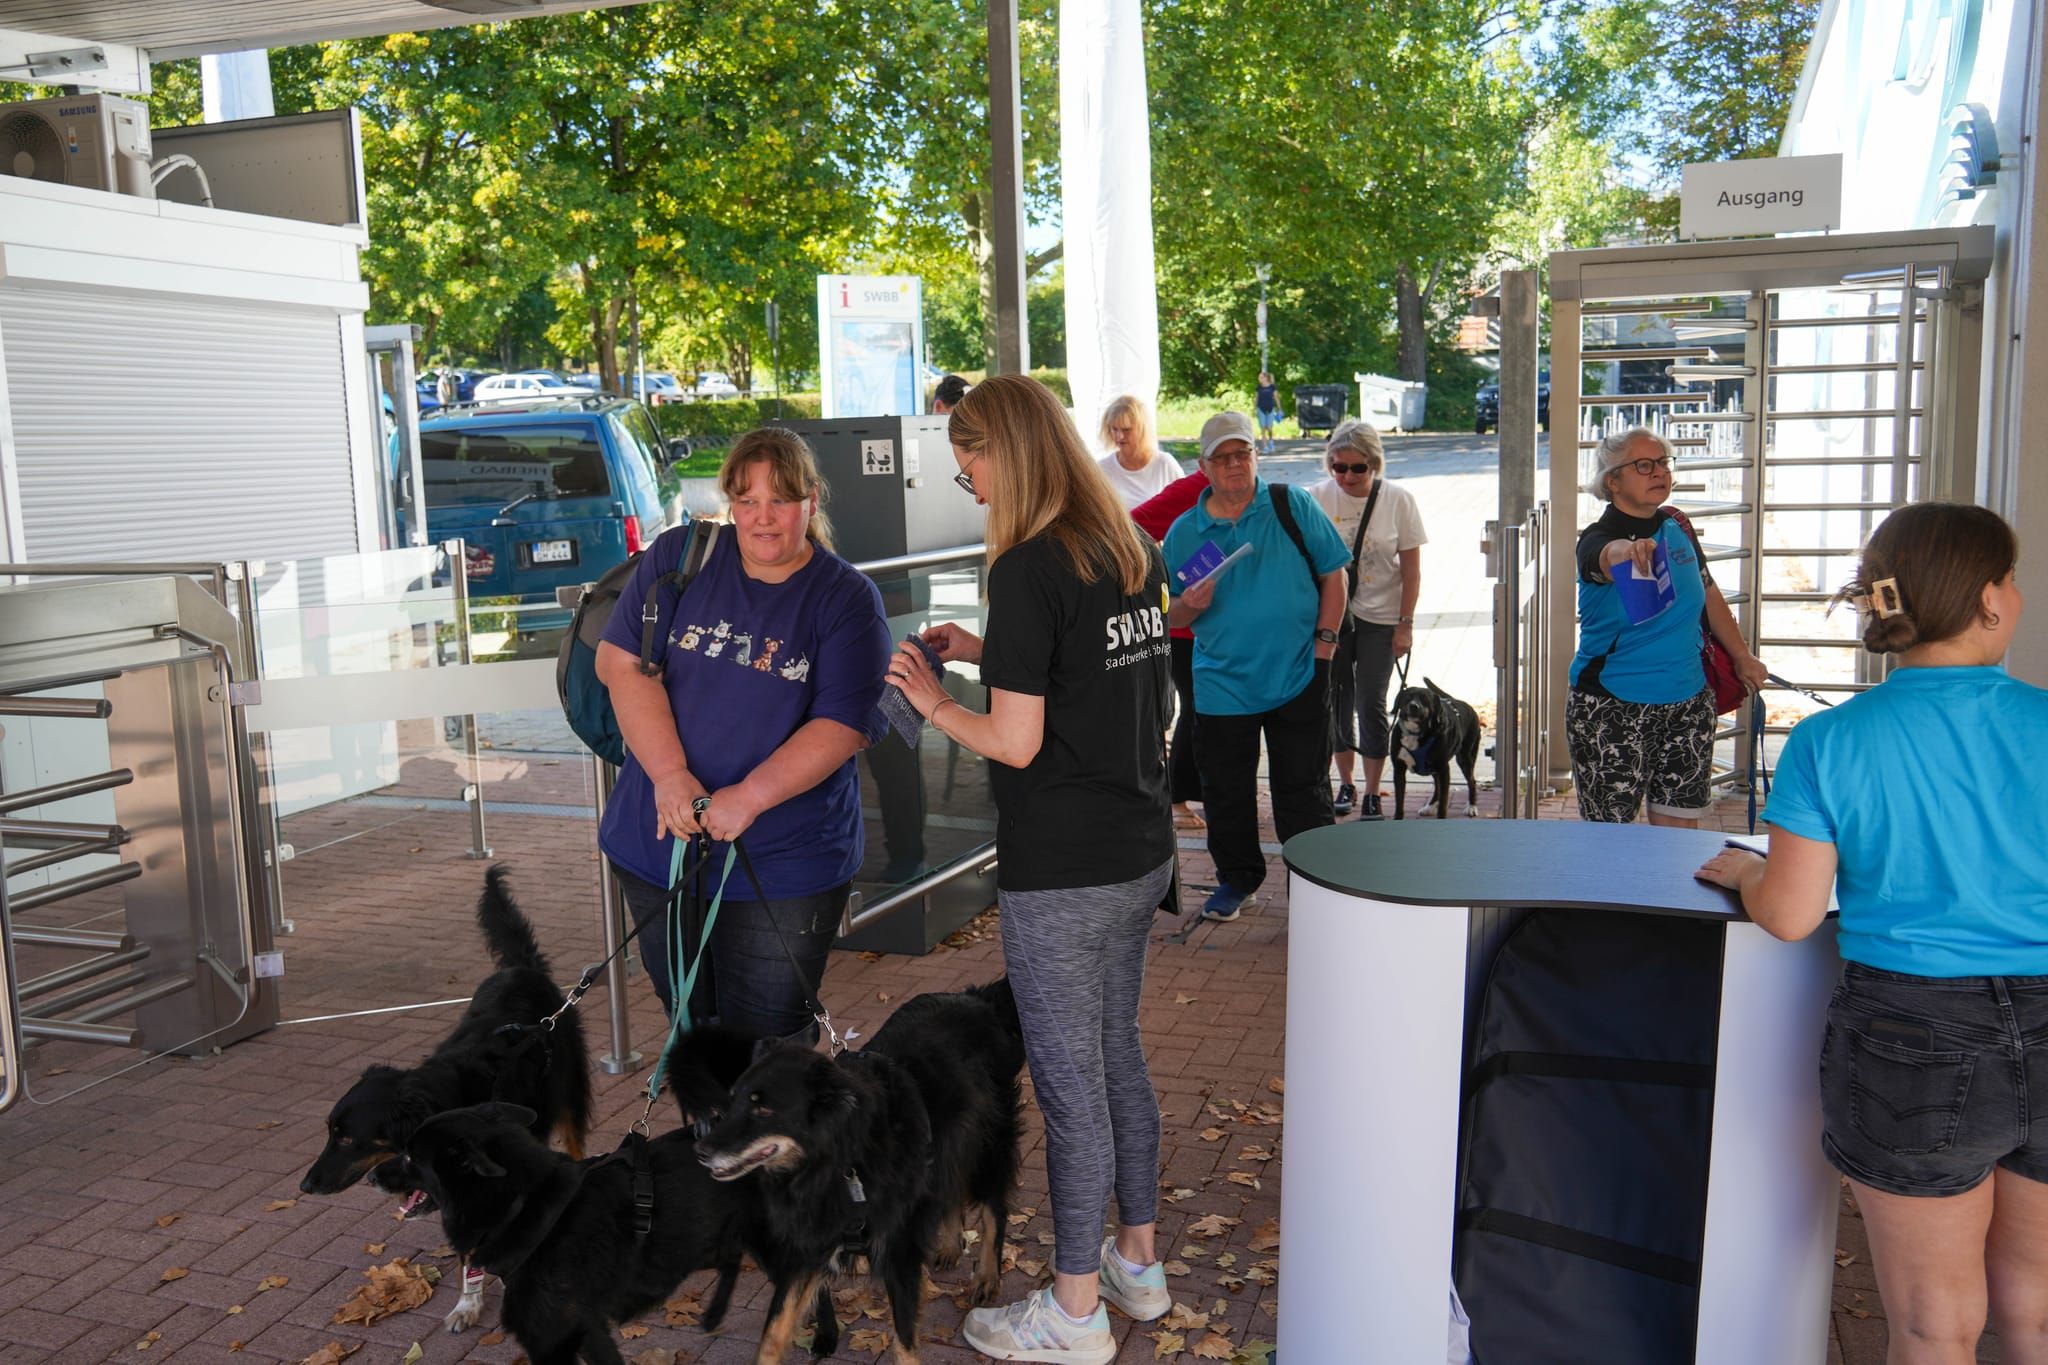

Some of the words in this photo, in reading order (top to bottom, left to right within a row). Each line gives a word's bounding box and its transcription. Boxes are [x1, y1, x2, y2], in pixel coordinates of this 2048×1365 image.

[59, 104, 97, 117] SAMSUNG
[1717, 189, 1803, 209] Ausgang
[864, 290, 899, 303] SWBB
[1105, 647, 1148, 671] Sadtwerke
